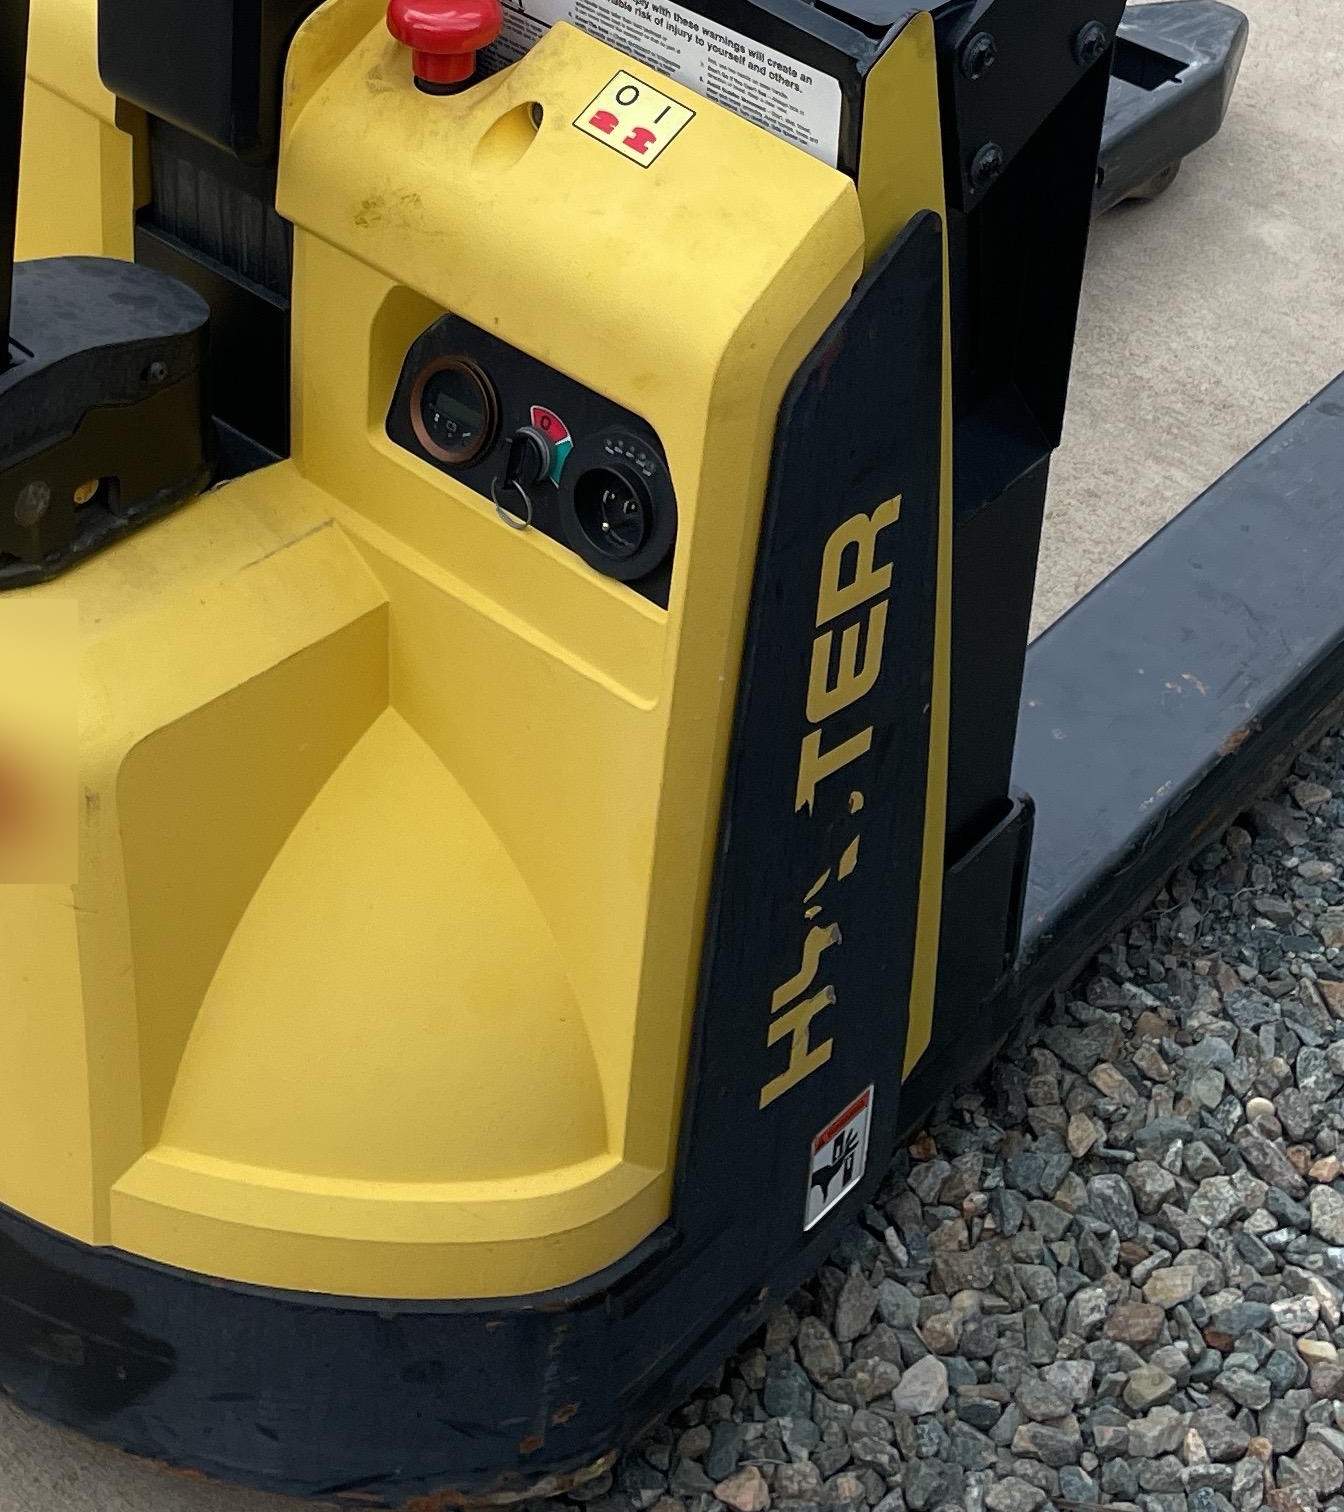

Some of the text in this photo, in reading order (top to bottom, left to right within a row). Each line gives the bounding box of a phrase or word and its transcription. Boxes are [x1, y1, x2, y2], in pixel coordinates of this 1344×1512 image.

[634, 7, 652, 23] risk
[654, 16, 664, 28] of
[665, 20, 693, 44] injury
[695, 34, 705, 47] to
[707, 41, 746, 65] yourself
[748, 60, 767, 76] and
[768, 70, 803, 94] others.
[651, 2, 671, 19] with
[673, 12, 700, 32] these
[702, 27, 746, 54] warnings
[748, 48, 765, 63] will
[767, 57, 798, 78] create
[799, 73, 813, 86] an
[758, 494, 903, 1111] HYTER
